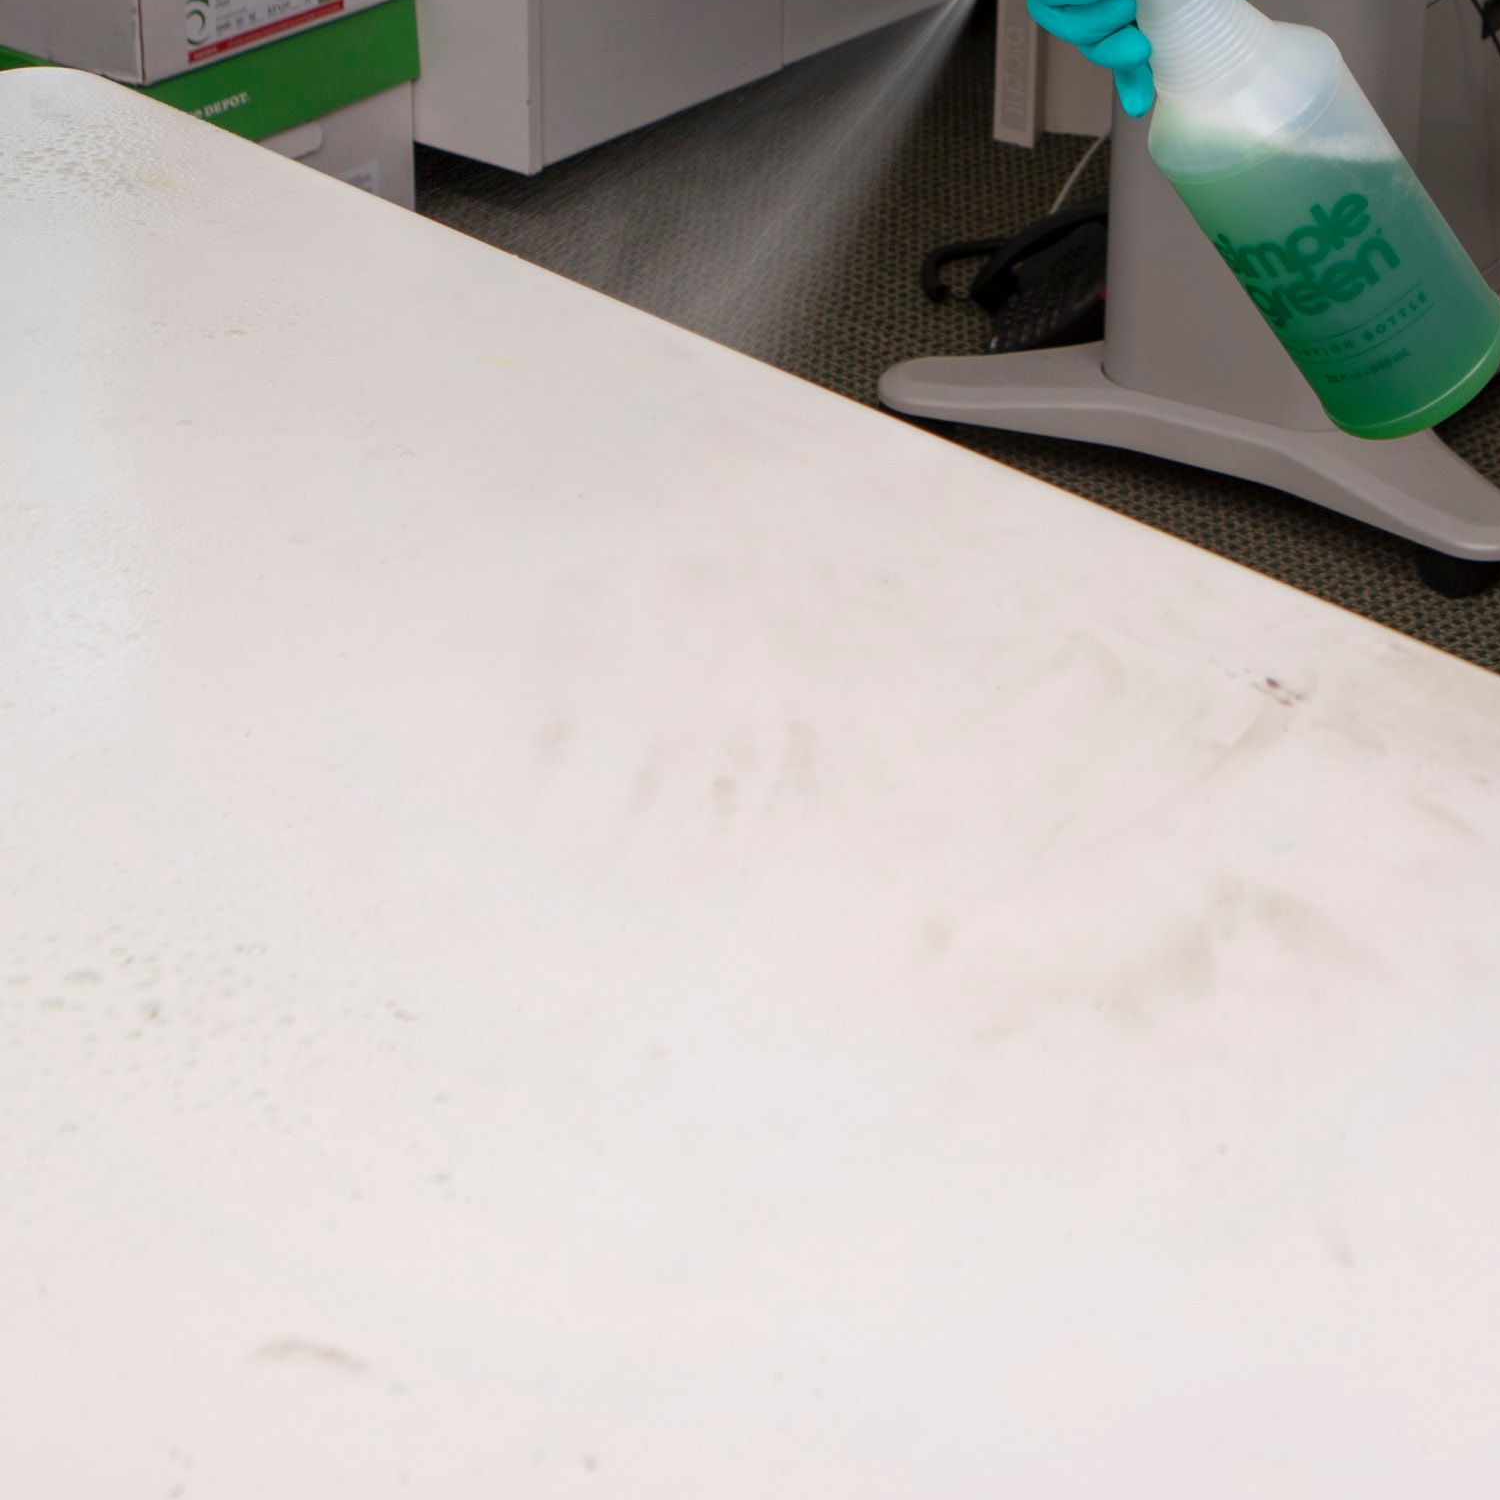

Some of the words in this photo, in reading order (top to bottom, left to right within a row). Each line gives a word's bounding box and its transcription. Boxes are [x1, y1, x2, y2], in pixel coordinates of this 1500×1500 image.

[204, 91, 250, 118] DEPOT
[1245, 236, 1401, 329] green
[1362, 291, 1427, 342] BOTTLE
